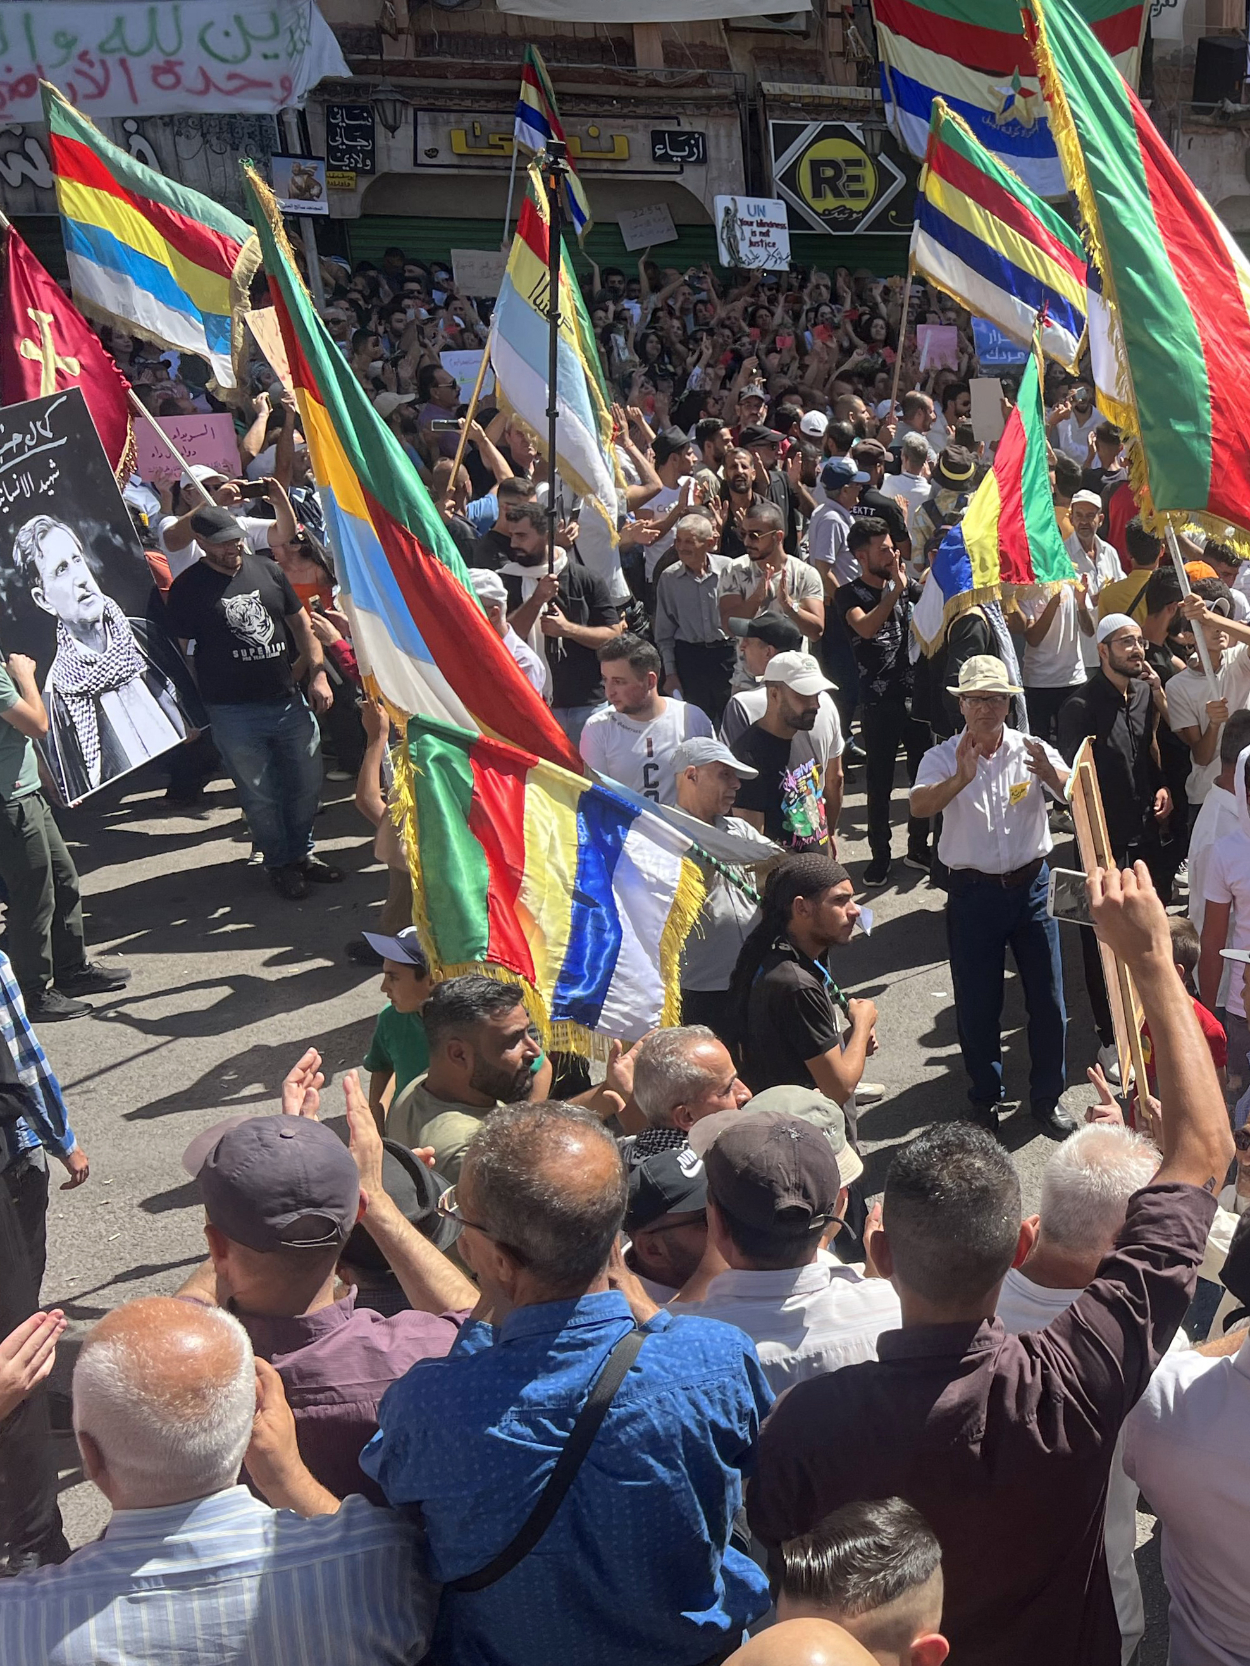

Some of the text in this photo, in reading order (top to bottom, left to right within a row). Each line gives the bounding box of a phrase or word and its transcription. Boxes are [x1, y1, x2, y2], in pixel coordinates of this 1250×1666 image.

[98, 4, 182, 58] لله
[151, 58, 293, 107] وحدة
[328, 127, 373, 150] رجالي
[654, 131, 704, 163] أزياء
[328, 152, 372, 171] ولادي
[809, 157, 868, 201] RE
[746, 204, 767, 218] UN
[820, 205, 864, 221] بوتيك
[738, 218, 787, 230] Your blindness
[750, 229, 771, 238] is not
[172, 423, 216, 442] السويداء
